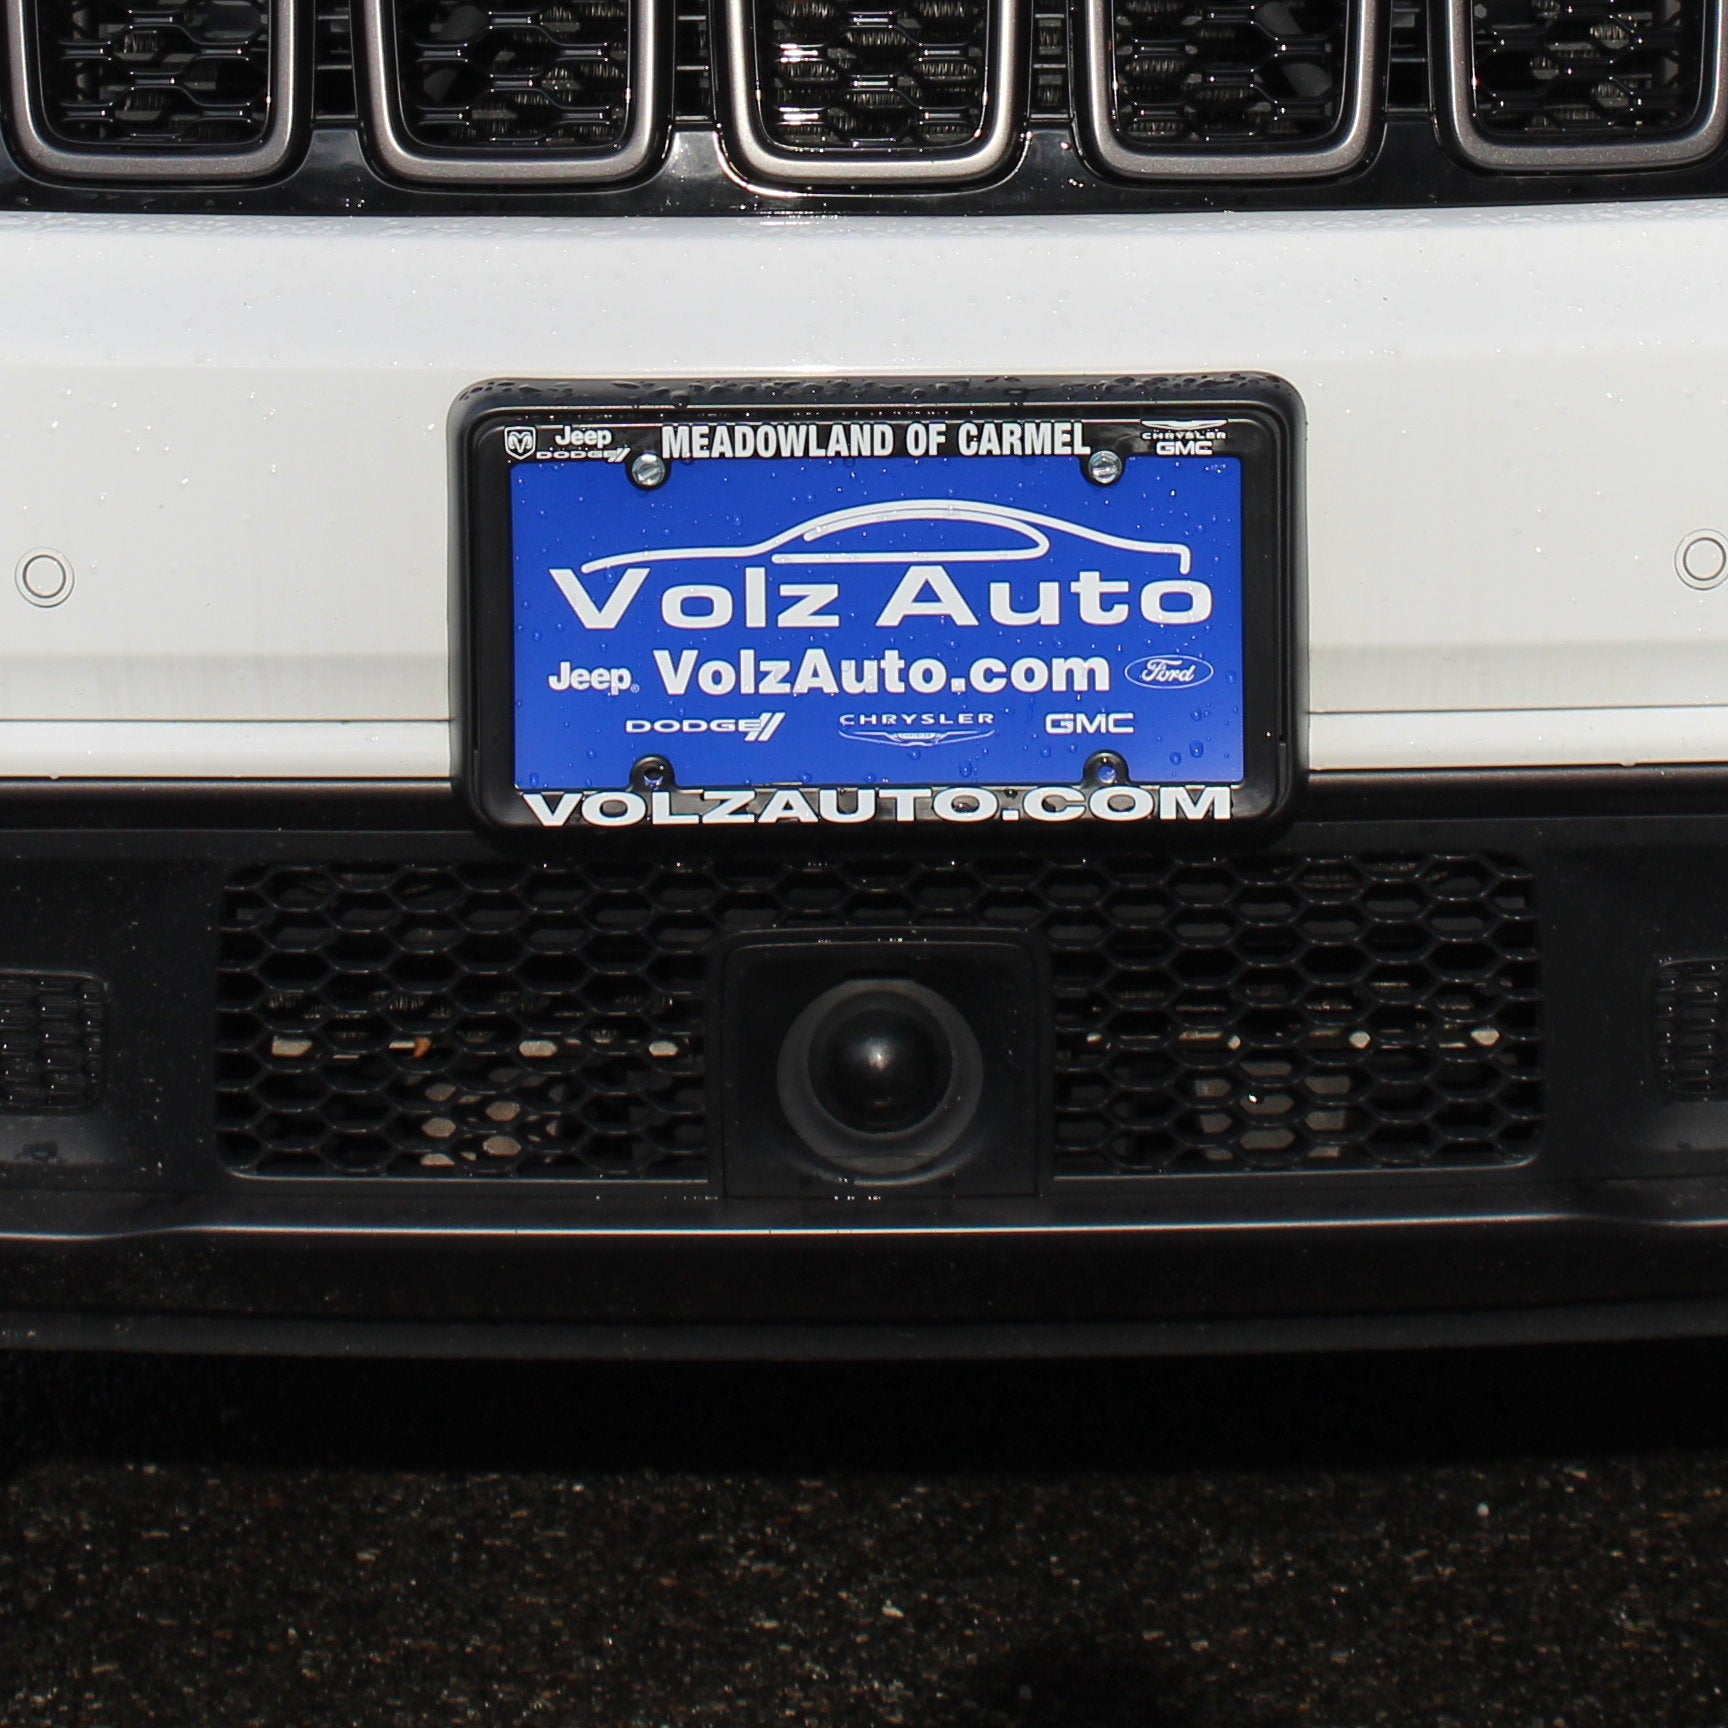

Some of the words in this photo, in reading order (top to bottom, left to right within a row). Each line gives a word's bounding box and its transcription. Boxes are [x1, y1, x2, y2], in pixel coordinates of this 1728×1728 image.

[554, 425, 613, 448] Jeep
[661, 424, 894, 459] MEADOWLAND
[906, 423, 947, 457] OF
[958, 422, 1091, 456] CARMEL
[1156, 440, 1213, 456] GMC
[536, 450, 620, 460] DODGE
[549, 566, 840, 629] Volz
[875, 564, 1214, 627] Auto
[548, 661, 633, 696] Jeep
[652, 647, 1110, 696] VolzAuto.com
[1139, 658, 1195, 683] Ford
[625, 718, 762, 733] DODGE
[839, 713, 994, 725] CHRYSLER
[1045, 712, 1134, 735] GMC
[522, 785, 1233, 828] VOLZAUTO.COM
